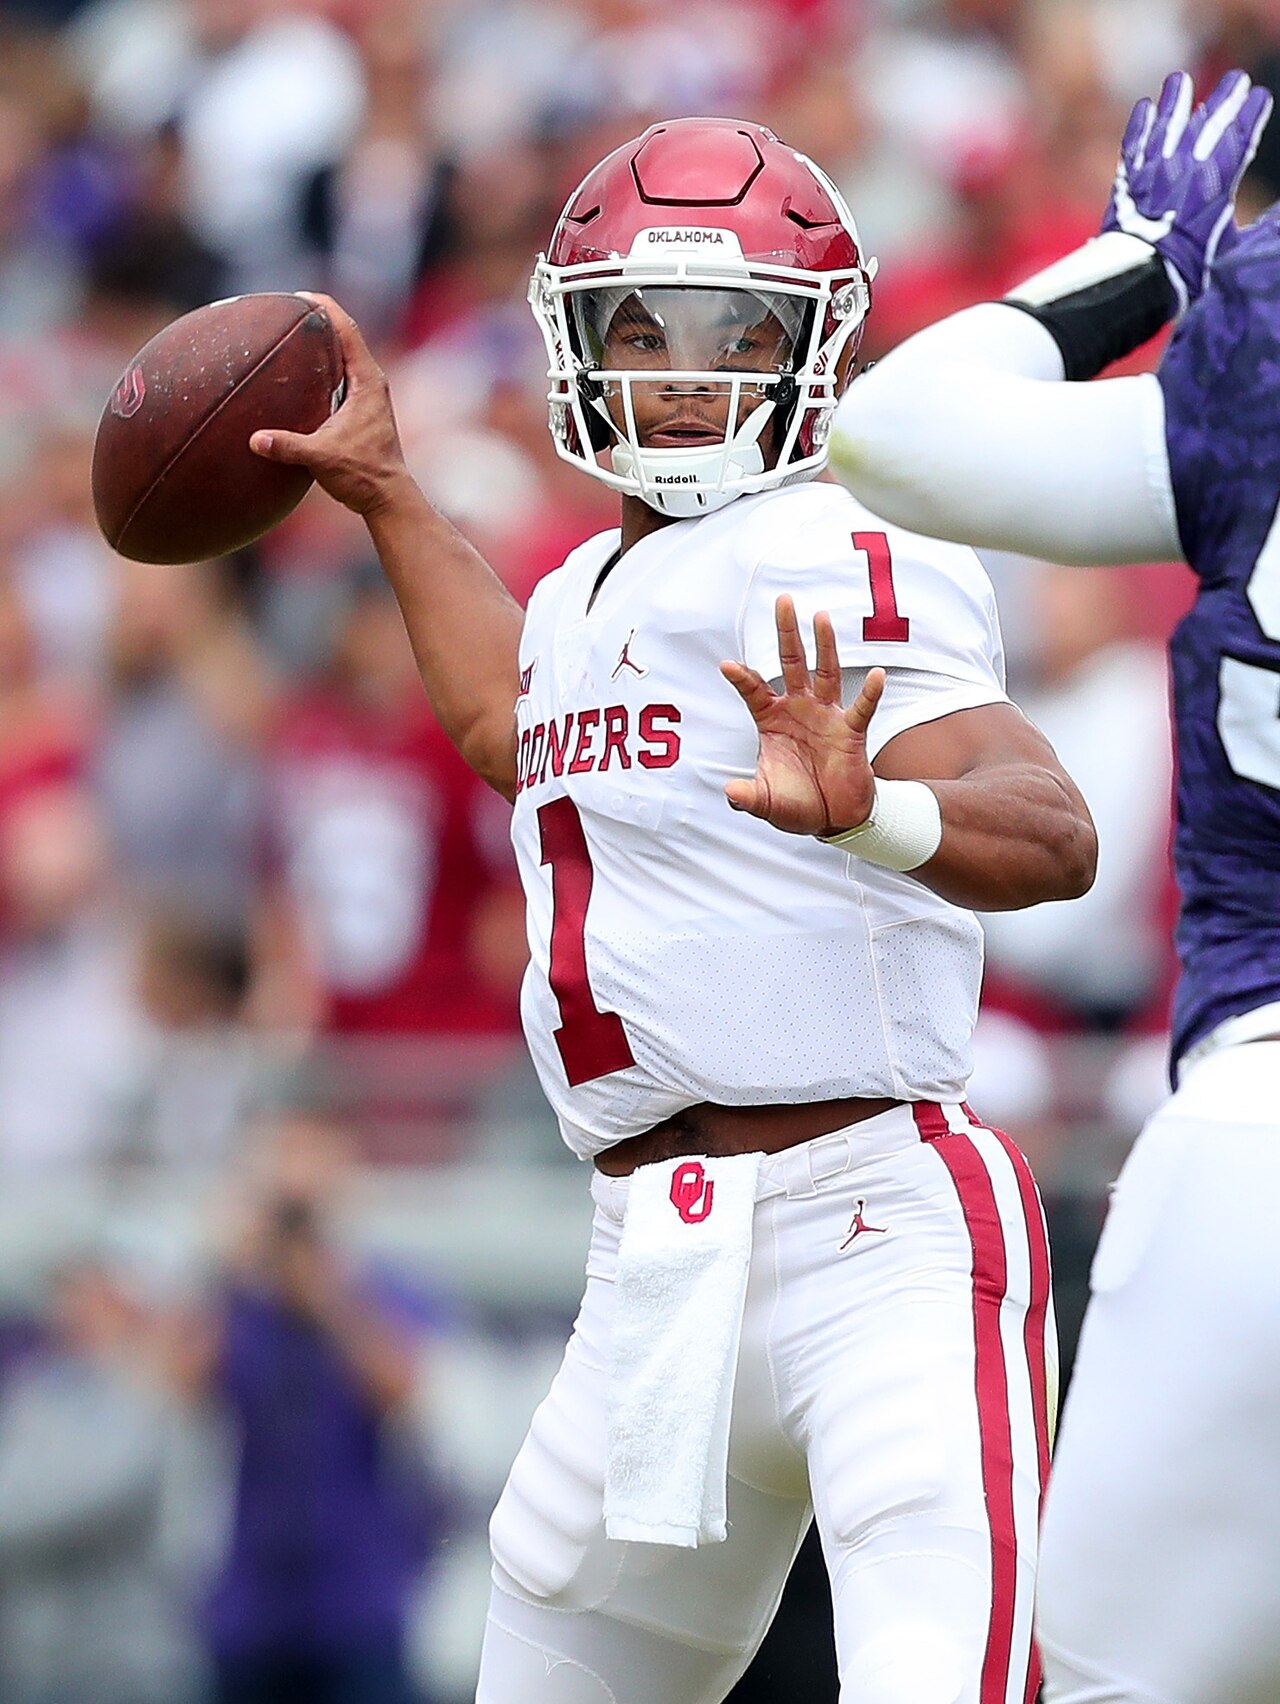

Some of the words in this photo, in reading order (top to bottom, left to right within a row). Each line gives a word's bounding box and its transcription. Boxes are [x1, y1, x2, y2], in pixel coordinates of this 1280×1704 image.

[647, 230, 724, 244] OKLAHOMA
[851, 531, 910, 642] 1
[516, 704, 681, 795] OONERS
[537, 795, 636, 1088] 1
